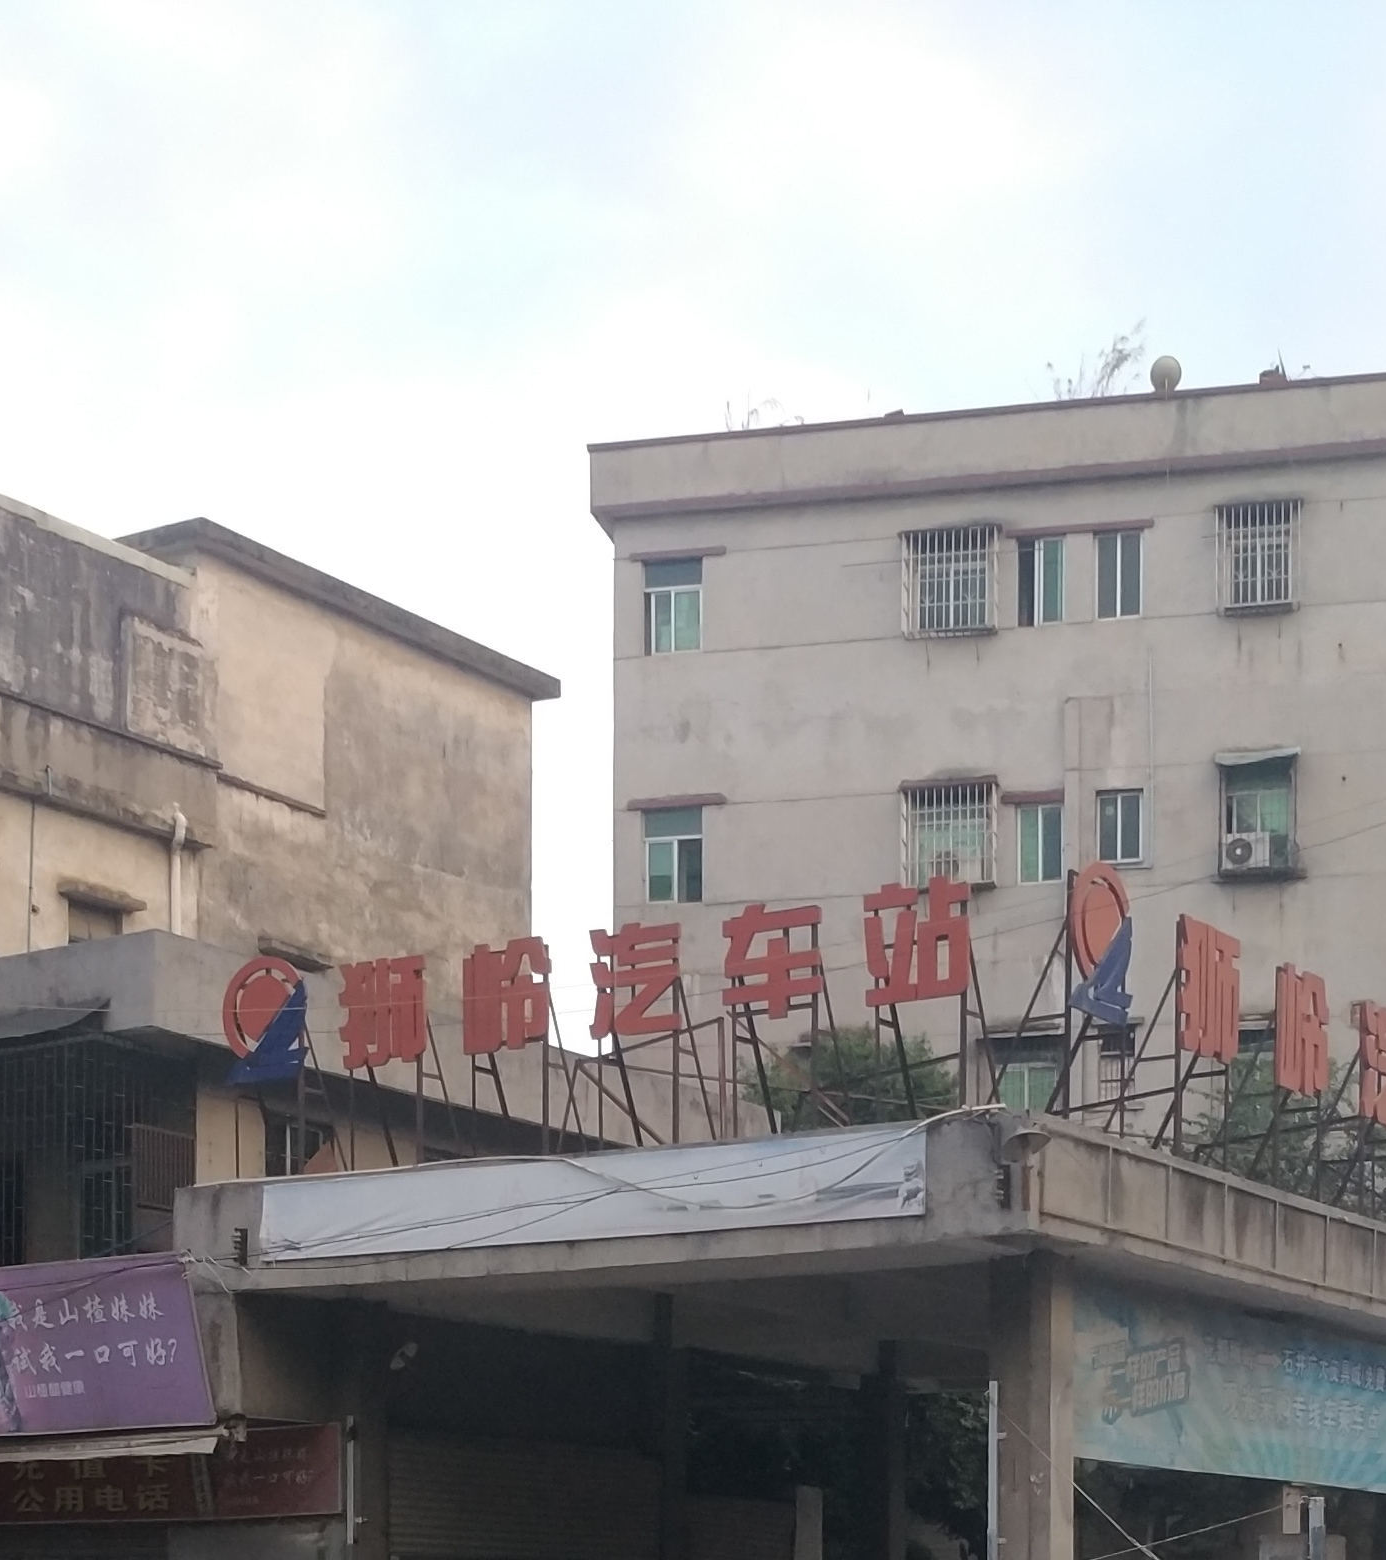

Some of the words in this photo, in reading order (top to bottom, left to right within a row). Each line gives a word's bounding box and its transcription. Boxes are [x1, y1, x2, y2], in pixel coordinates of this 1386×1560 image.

[338, 874, 971, 1070] 狮岭汽车站
[8, 1290, 165, 1331] 我是山楂妹妹
[9, 1482, 172, 1514] 公用电话
